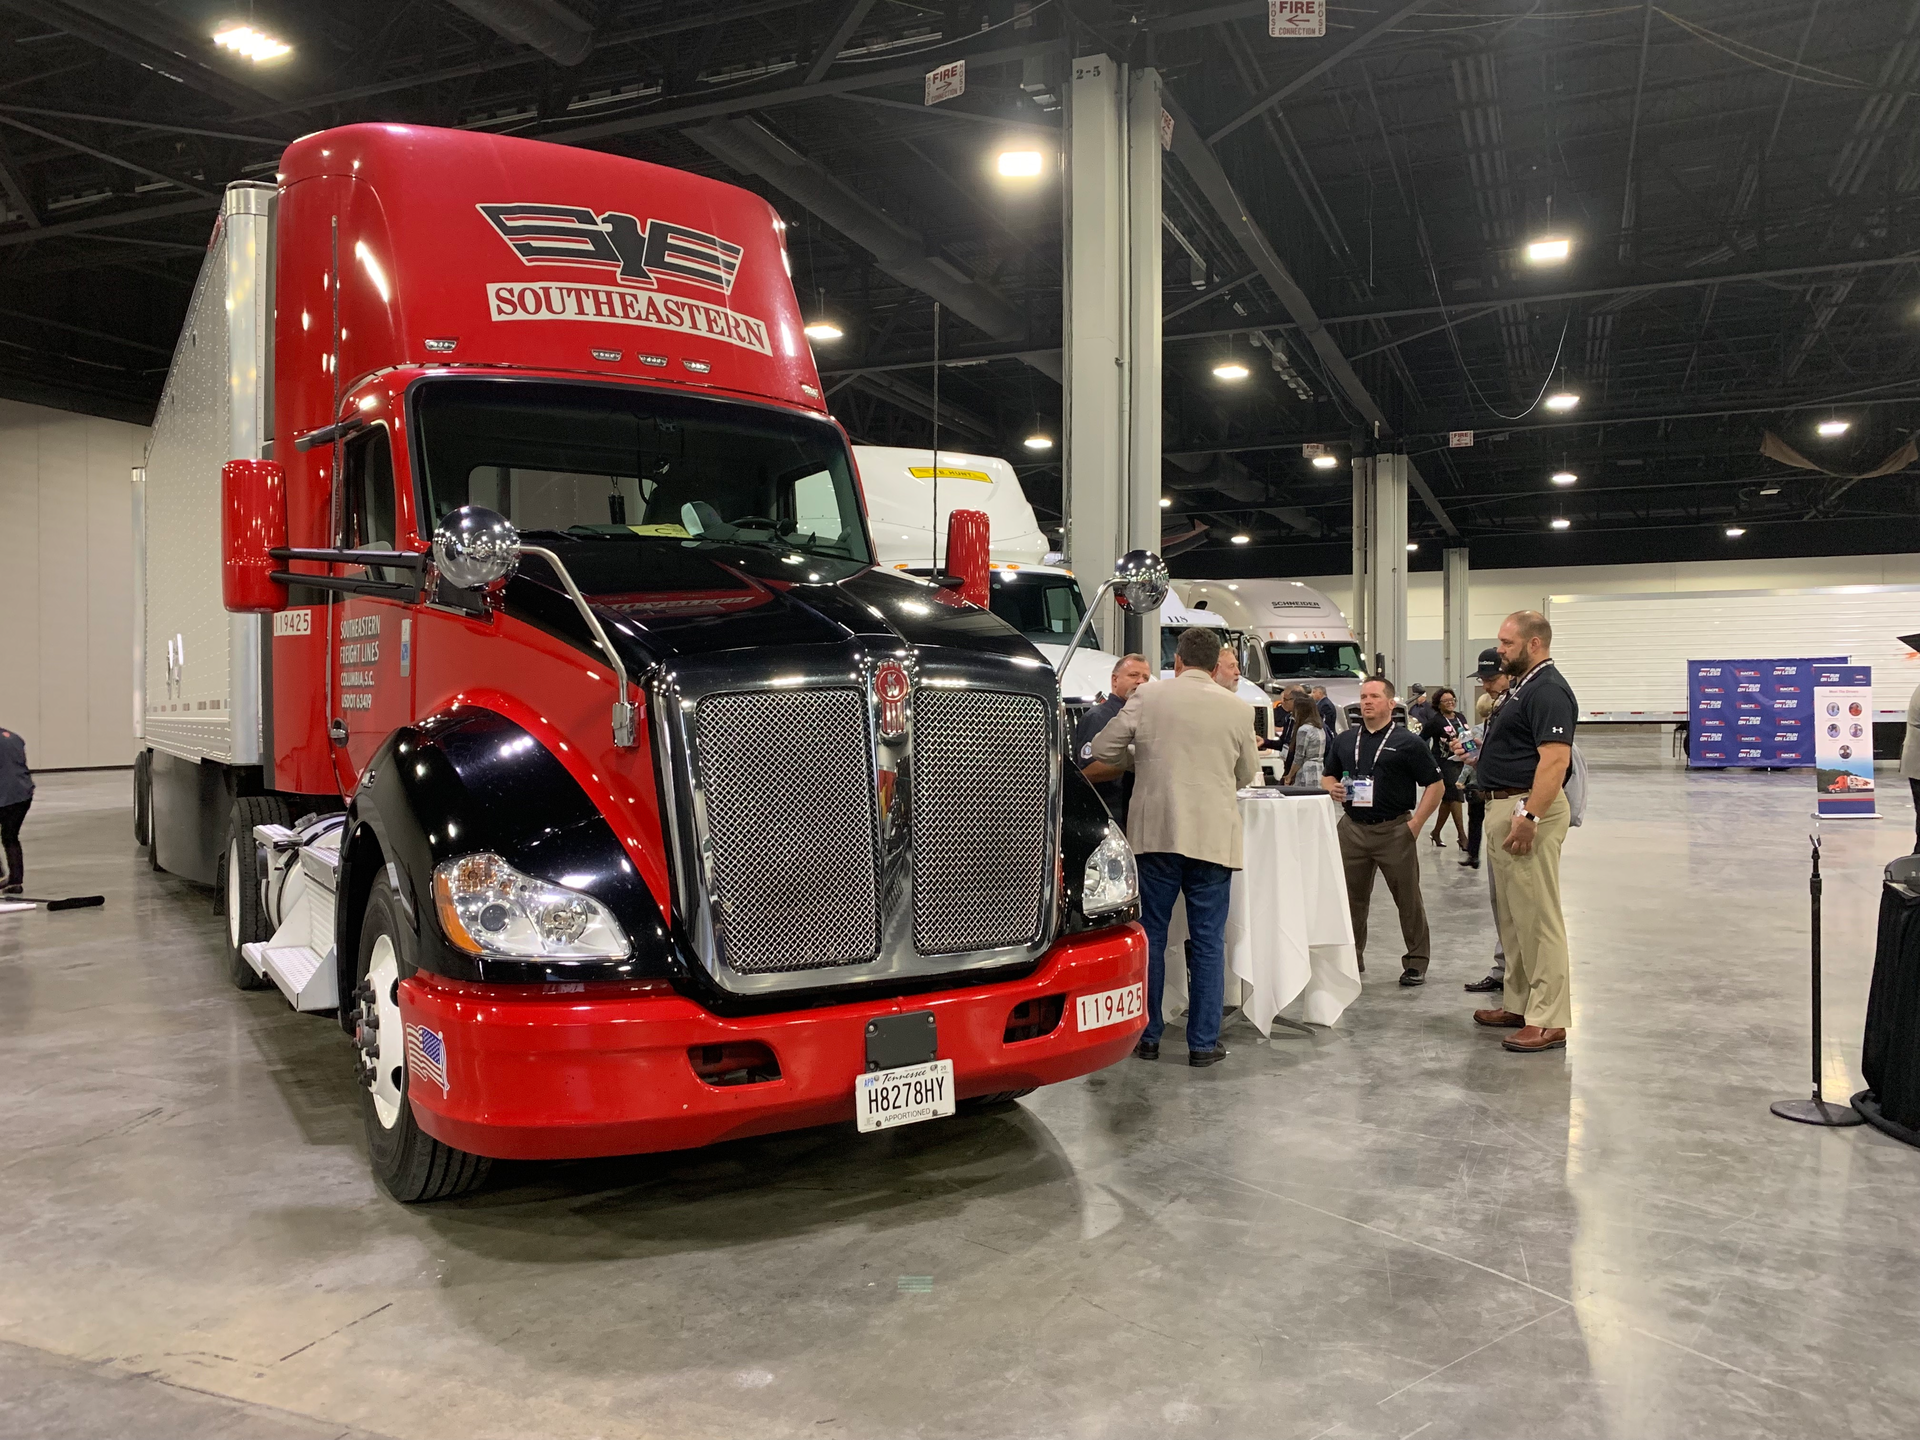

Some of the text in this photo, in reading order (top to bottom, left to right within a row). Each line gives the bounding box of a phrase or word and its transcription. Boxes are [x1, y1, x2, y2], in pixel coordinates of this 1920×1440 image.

[1279, 1, 1315, 14] FIRE
[1279, 27, 1316, 36] CONNECTION
[932, 65, 958, 85] FIRE
[1076, 65, 1101, 80] 2-5
[931, 88, 958, 102] CONNECTION
[494, 286, 766, 350] SOUTHEASTERN
[275, 613, 310, 633] 119425
[340, 615, 380, 639] SOUTHEASTERN
[340, 641, 379, 664] FREIGHT LINES
[1081, 986, 1142, 1026] 119425
[864, 1078, 874, 1087] APR
[882, 1069, 927, 1085] Tennessee
[868, 1076, 944, 1114] H8278HY
[884, 1108, 930, 1122] APPORTIONED
